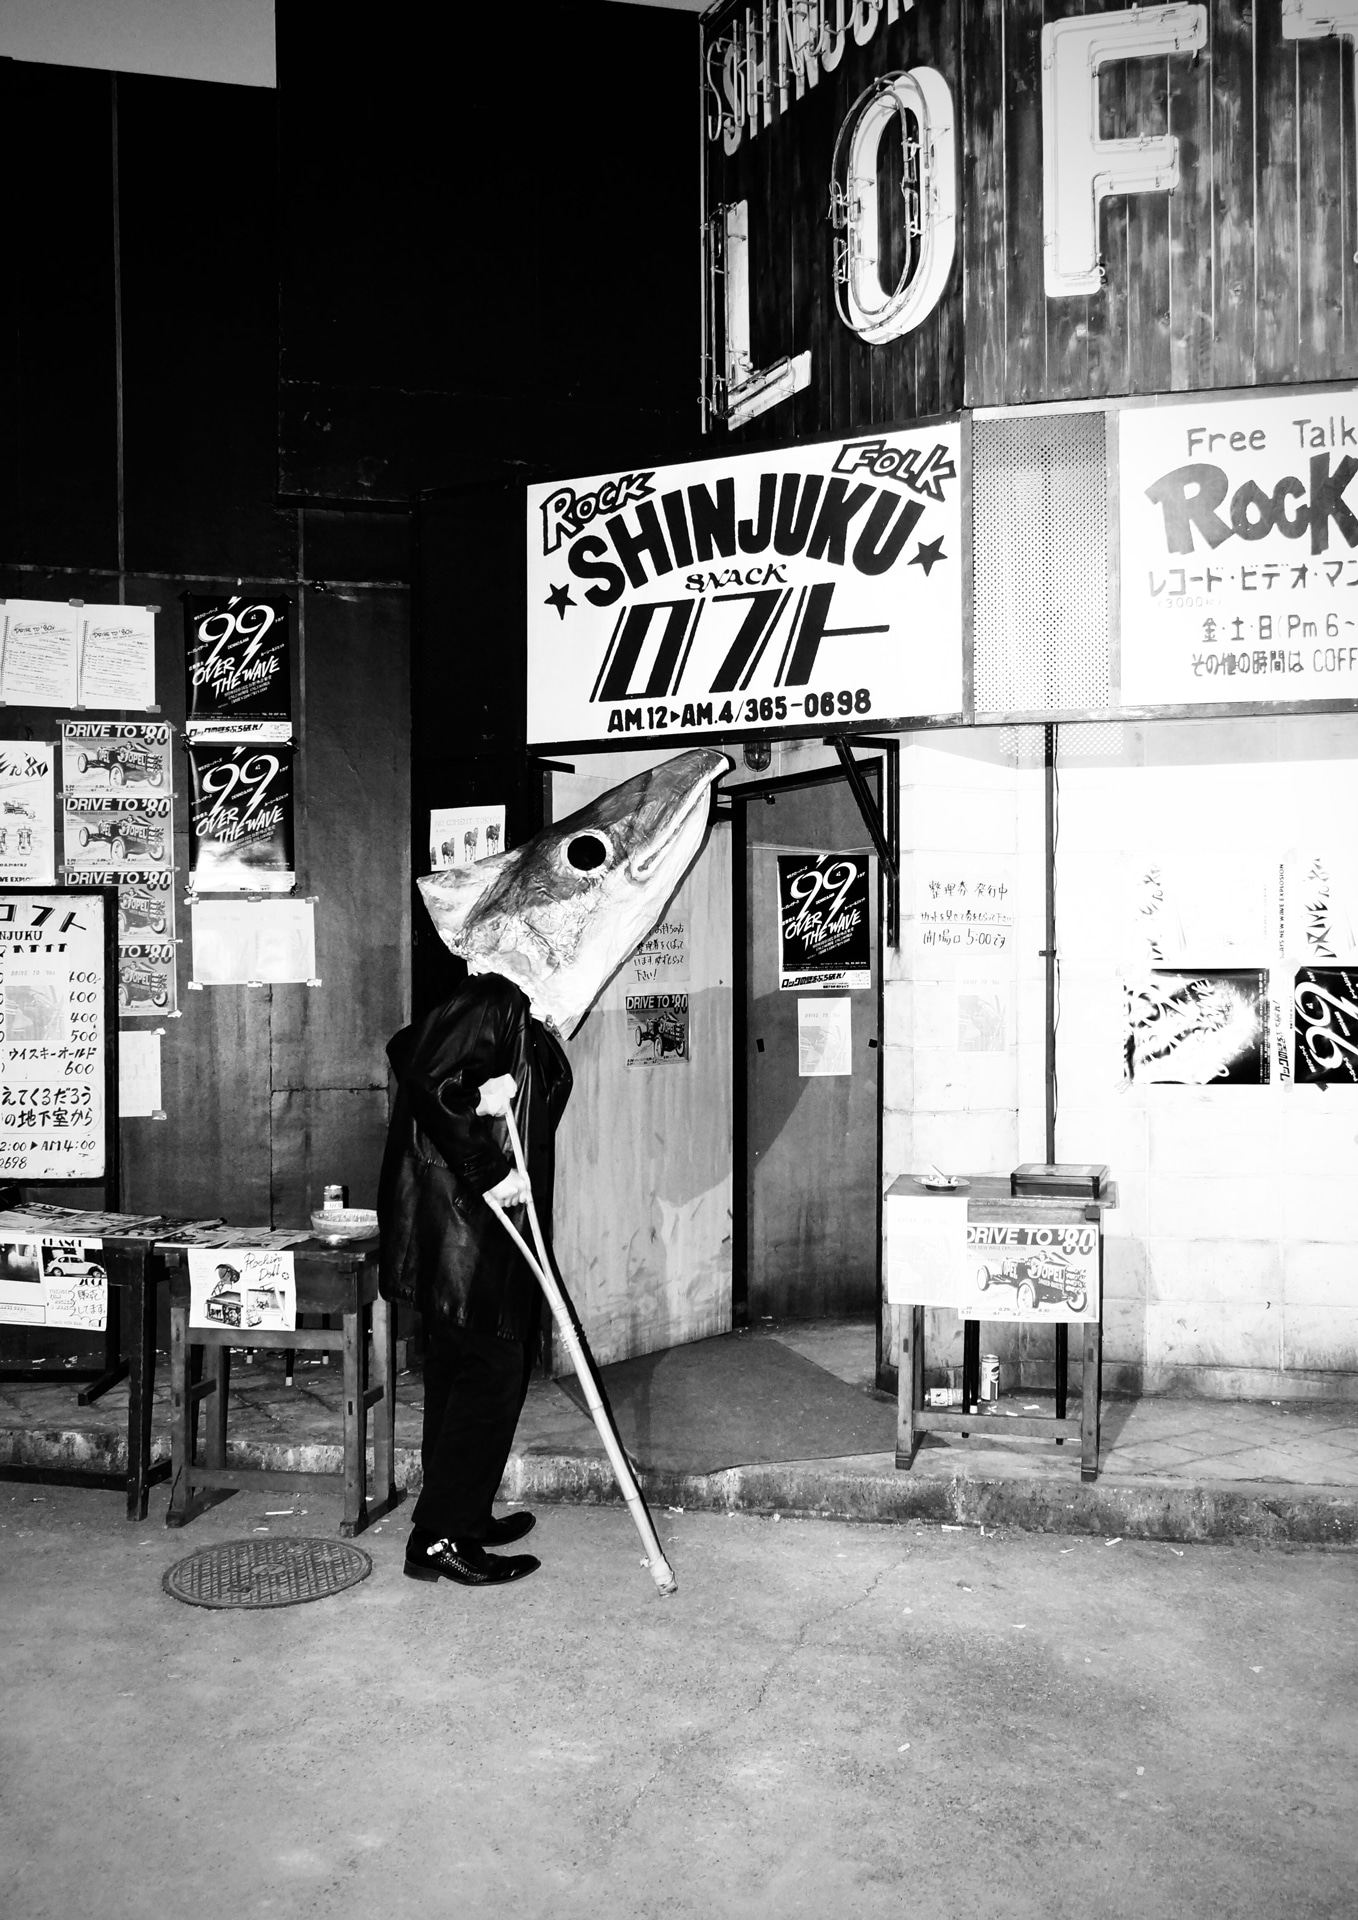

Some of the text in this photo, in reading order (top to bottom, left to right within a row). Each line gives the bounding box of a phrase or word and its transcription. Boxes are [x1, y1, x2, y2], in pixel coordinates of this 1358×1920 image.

[713, 0, 1358, 430] LOF
[1187, 416, 1358, 457] Free Talk
[540, 440, 956, 556] ROCK FOLK
[568, 473, 926, 607] SHINJUKU
[685, 563, 787, 592] SNACK
[192, 657, 235, 686] OVER
[211, 670, 241, 699] THE
[242, 655, 280, 681] WAVE
[1191, 650, 1304, 677] その他の時間は
[65, 724, 169, 745] DRIVE TO '80
[128, 754, 147, 766] OPEL
[66, 798, 170, 818] DRIVE TO '80
[196, 807, 239, 836] OVER
[215, 805, 284, 843] THE WAVE
[68, 871, 172, 891] DRIVE TO '80
[785, 912, 822, 940] OVER
[802, 926, 827, 951] THE
[826, 909, 861, 933] WAVE
[1304, 899, 1337, 958] DRIVE
[119, 945, 174, 964] TO '80
[70, 1012, 98, 1023] 400
[627, 994, 688, 1015] DRIVE TO '80
[70, 1029, 98, 1043] 500
[64, 1061, 94, 1076] 600
[1024, 1228, 1053, 1245] TO
[1058, 1229, 1096, 1255] '80
[1041, 1267, 1064, 1283] OPEL
